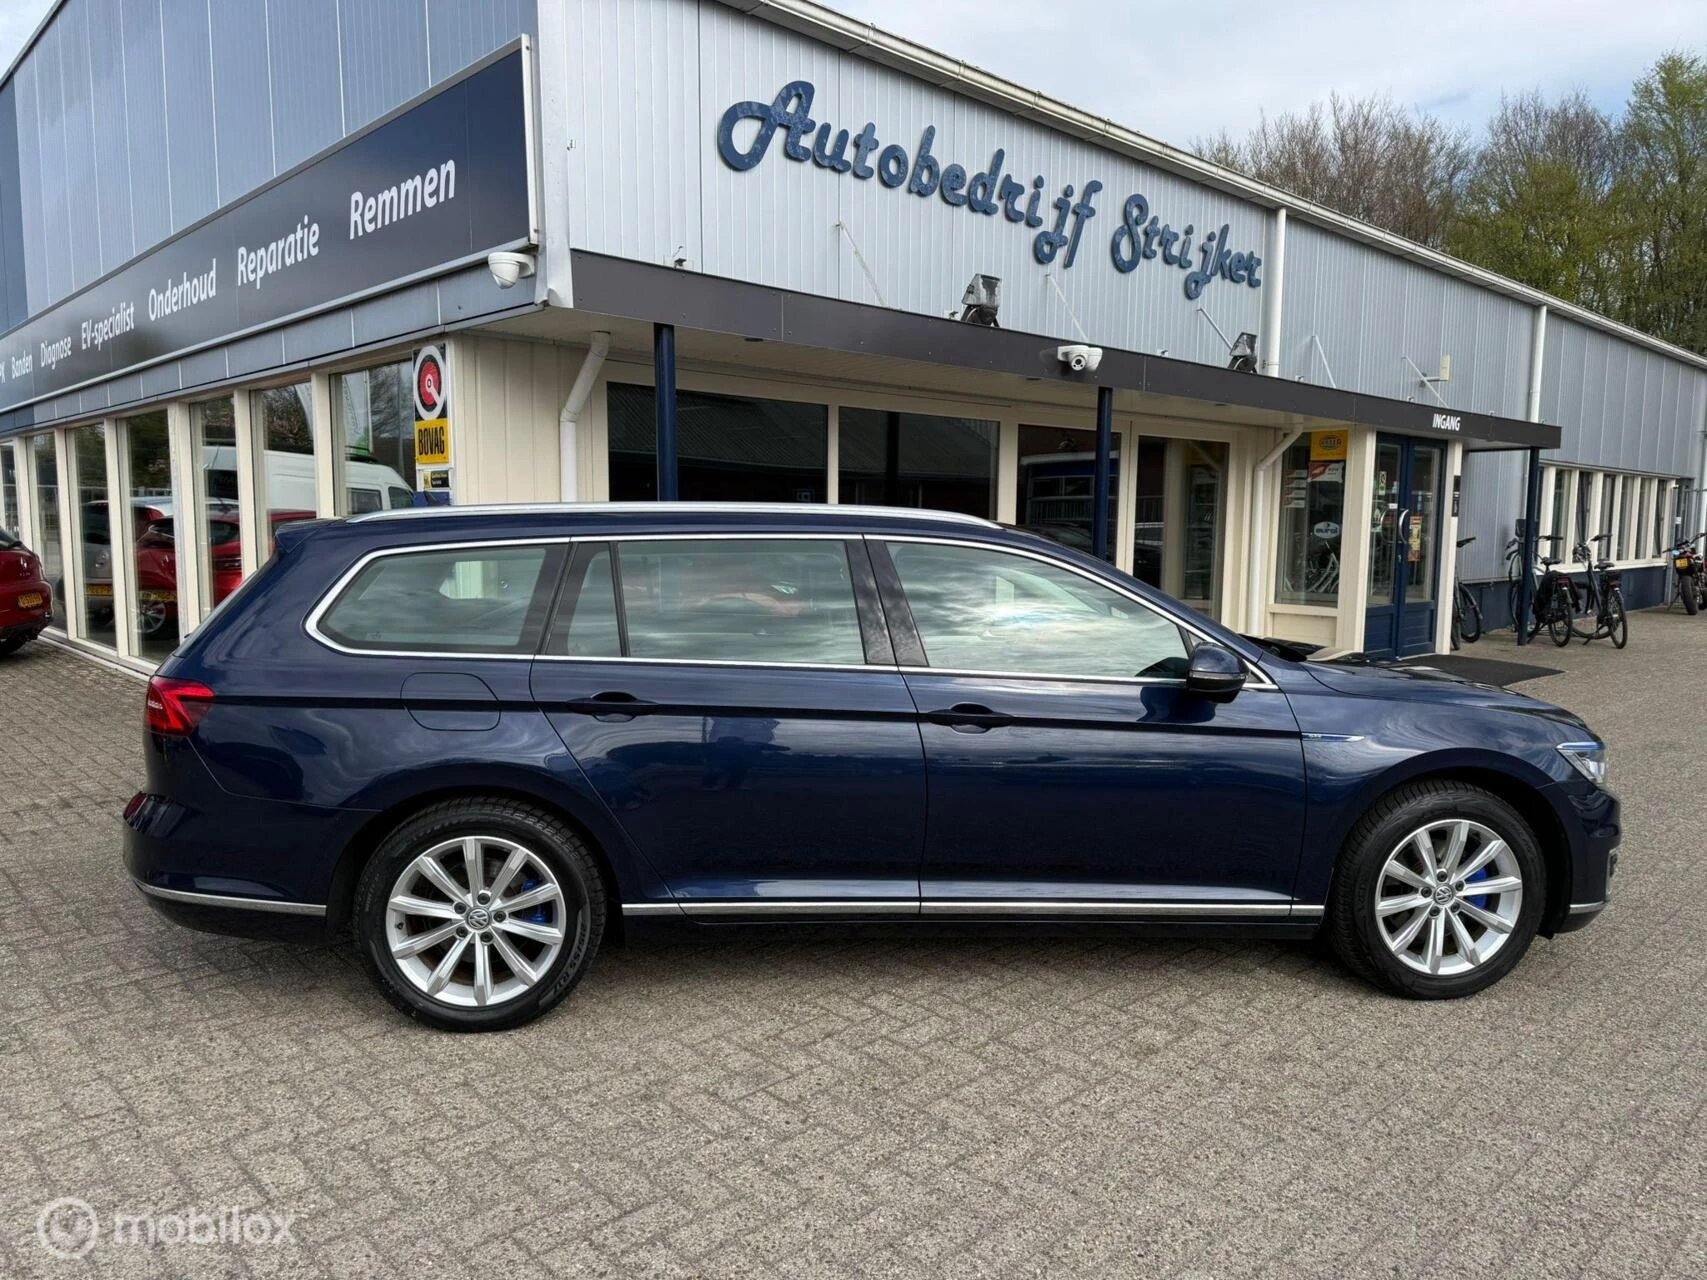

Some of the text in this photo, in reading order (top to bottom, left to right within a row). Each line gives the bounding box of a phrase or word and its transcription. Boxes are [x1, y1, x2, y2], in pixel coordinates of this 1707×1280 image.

[717, 79, 1262, 300] Autobedrijf Strijker
[11, 350, 33, 379] Banden
[40, 336, 72, 370] Diagnose
[81, 302, 135, 352] EV-specialist
[148, 258, 217, 322] Onderhoud
[237, 215, 320, 289] Reparatie
[349, 159, 456, 240] Remmen
[418, 427, 445, 455] BOVAG
[1432, 413, 1461, 431] INGANG
